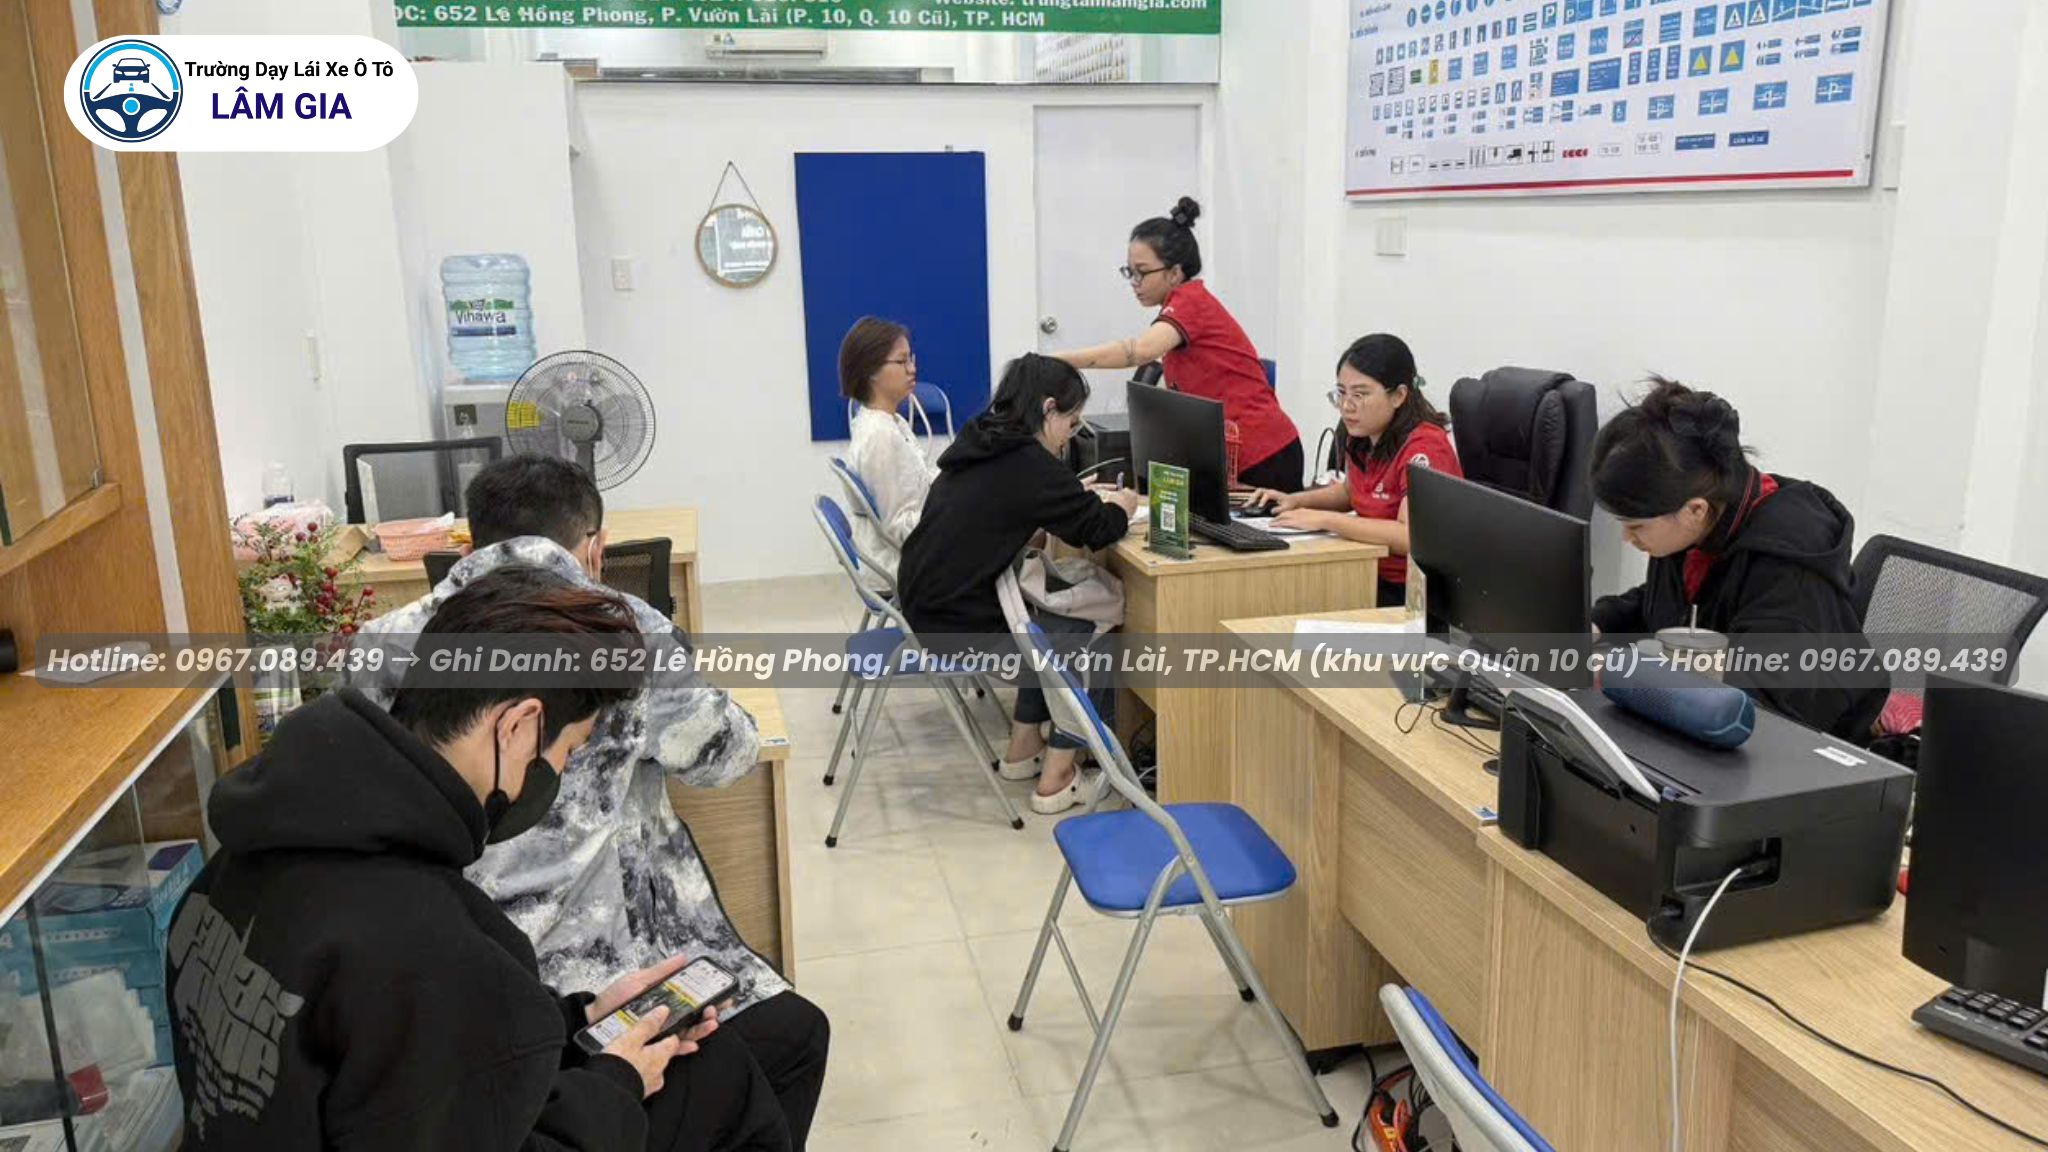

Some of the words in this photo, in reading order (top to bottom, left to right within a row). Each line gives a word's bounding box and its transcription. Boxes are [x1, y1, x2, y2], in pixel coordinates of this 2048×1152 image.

[434, 6, 477, 22] 652
[485, 6, 511, 22] Lê
[583, 7, 654, 25] Phong,
[662, 7, 681, 23] P.
[690, 7, 740, 23] Vườn
[747, 7, 778, 24] Lài
[786, 8, 812, 25] (P.
[822, 8, 852, 27] 10,
[859, 9, 879, 25] Q.
[888, 9, 911, 25] 10
[918, 9, 958, 29] Cũ),
[964, 10, 995, 27] TP.
[1002, 11, 1045, 27] HCM
